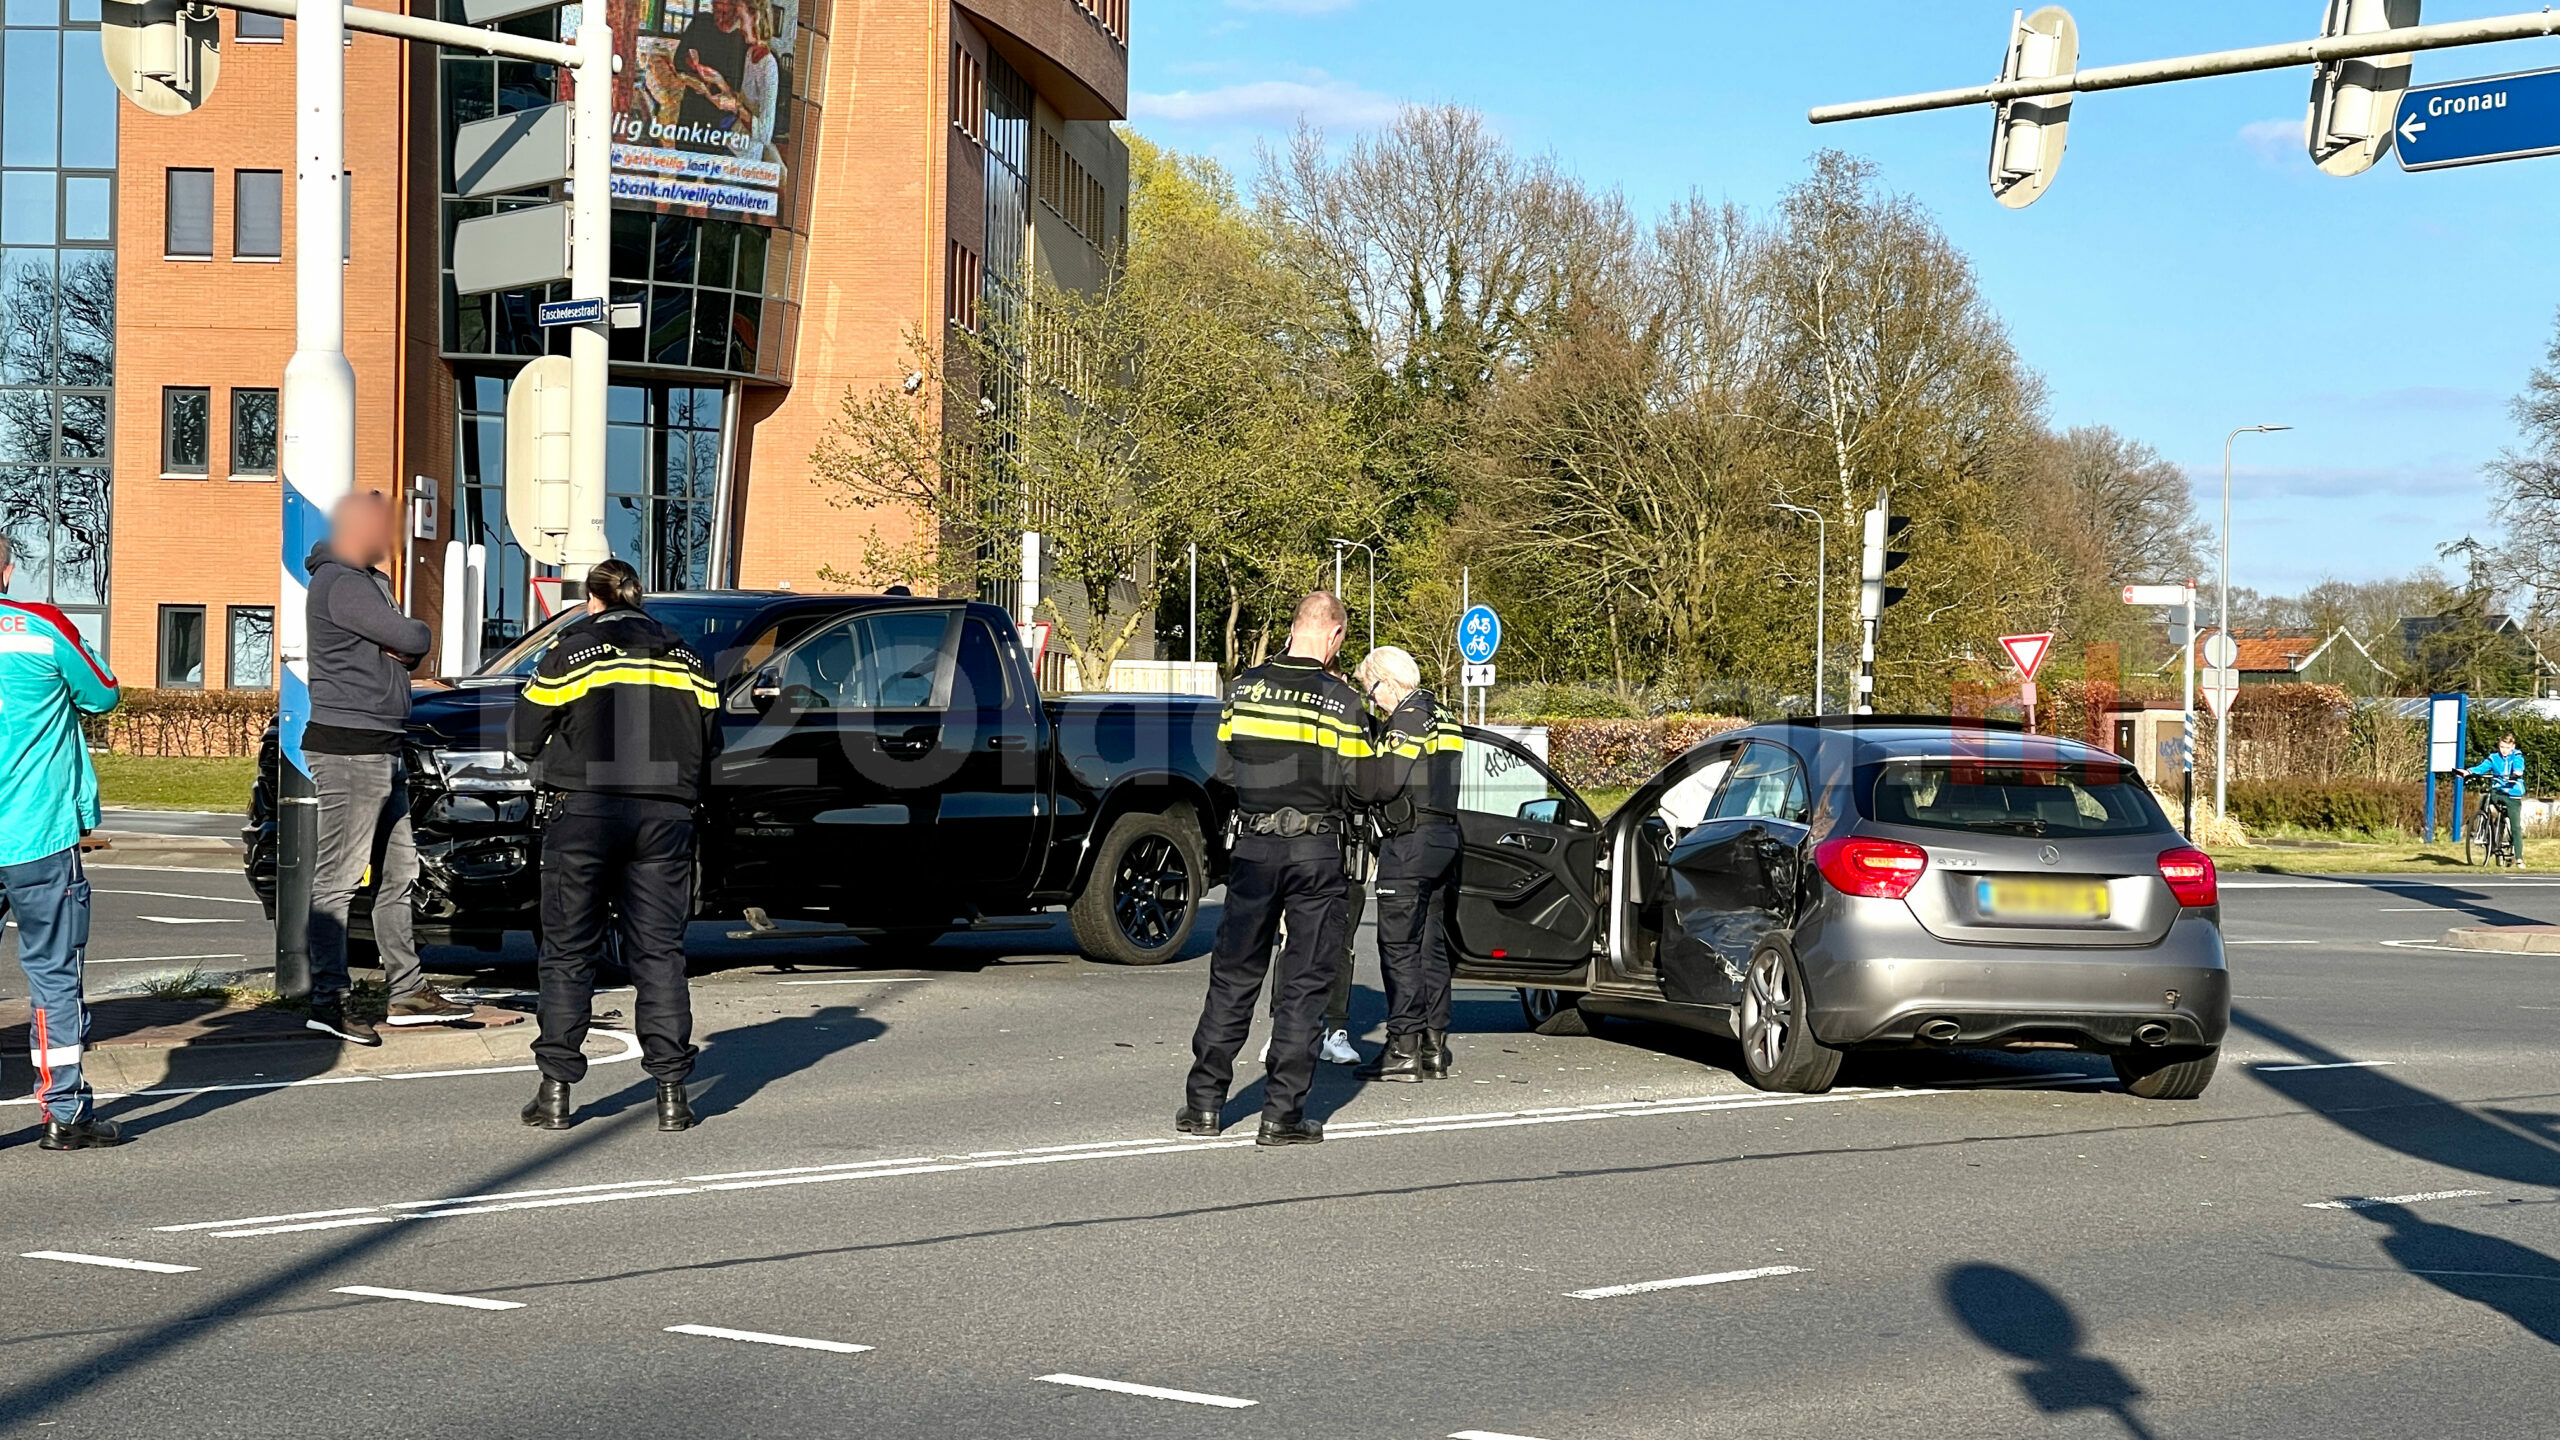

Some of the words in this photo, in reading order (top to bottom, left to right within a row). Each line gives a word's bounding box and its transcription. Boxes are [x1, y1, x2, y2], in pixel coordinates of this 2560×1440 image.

[2428, 92, 2507, 117] Gronau
[649, 115, 750, 150] bankieren
[687, 158, 710, 172] laat
[711, 162, 721, 175] je
[541, 303, 598, 321] Enschedesestraat
[1243, 679, 1312, 703] POLITIE
